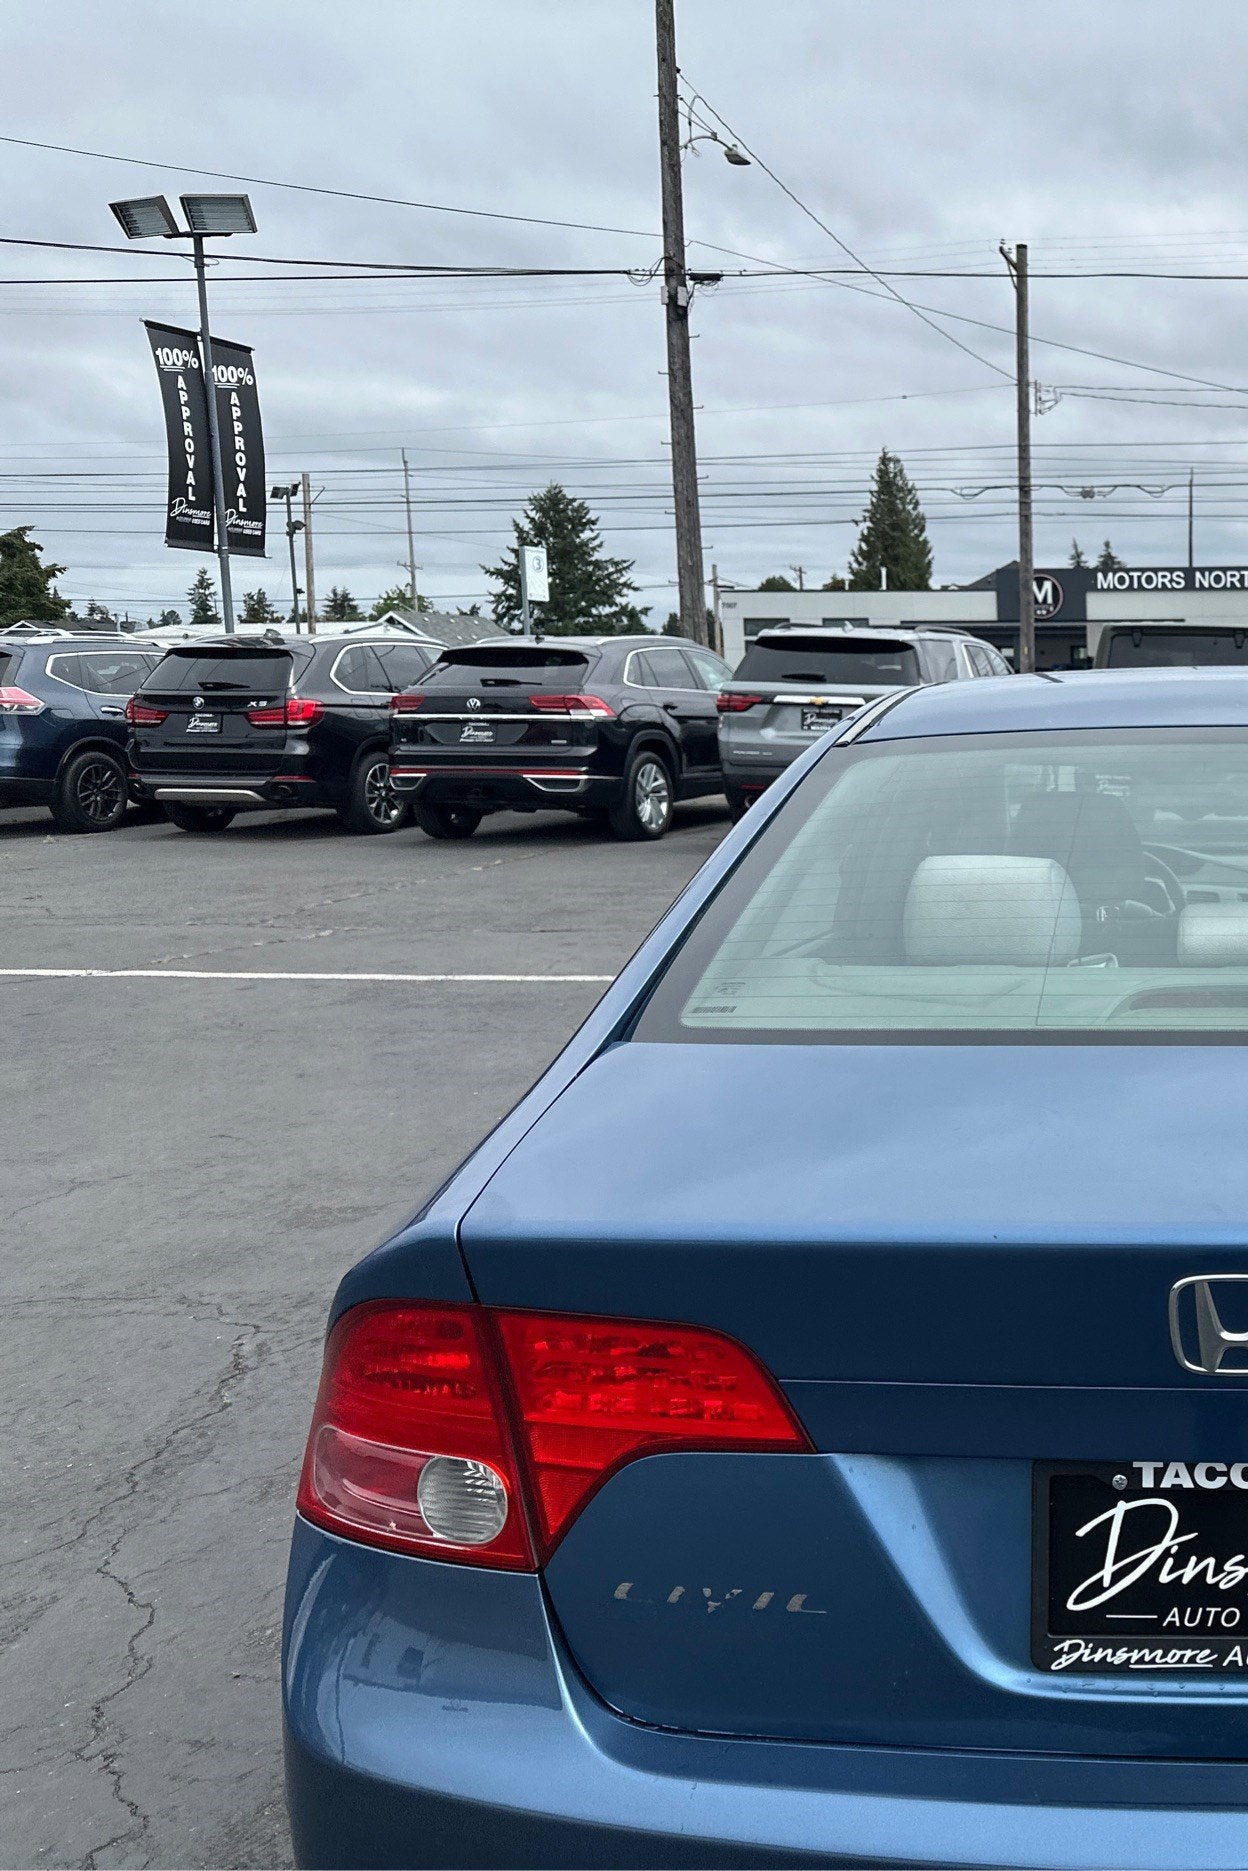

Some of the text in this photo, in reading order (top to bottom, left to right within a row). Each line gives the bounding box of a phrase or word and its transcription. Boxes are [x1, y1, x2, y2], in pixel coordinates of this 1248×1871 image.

[155, 347, 199, 369] 100%
[211, 365, 254, 385] 100%
[177, 375, 196, 501] APPROVAL
[230, 391, 247, 513] APPROVAL
[169, 497, 211, 518] Dinsmore
[1097, 571, 1186, 590] MOTORS
[1163, 1607, 1241, 1628] AUTO
[1051, 1639, 1218, 1670] Dinsmore
